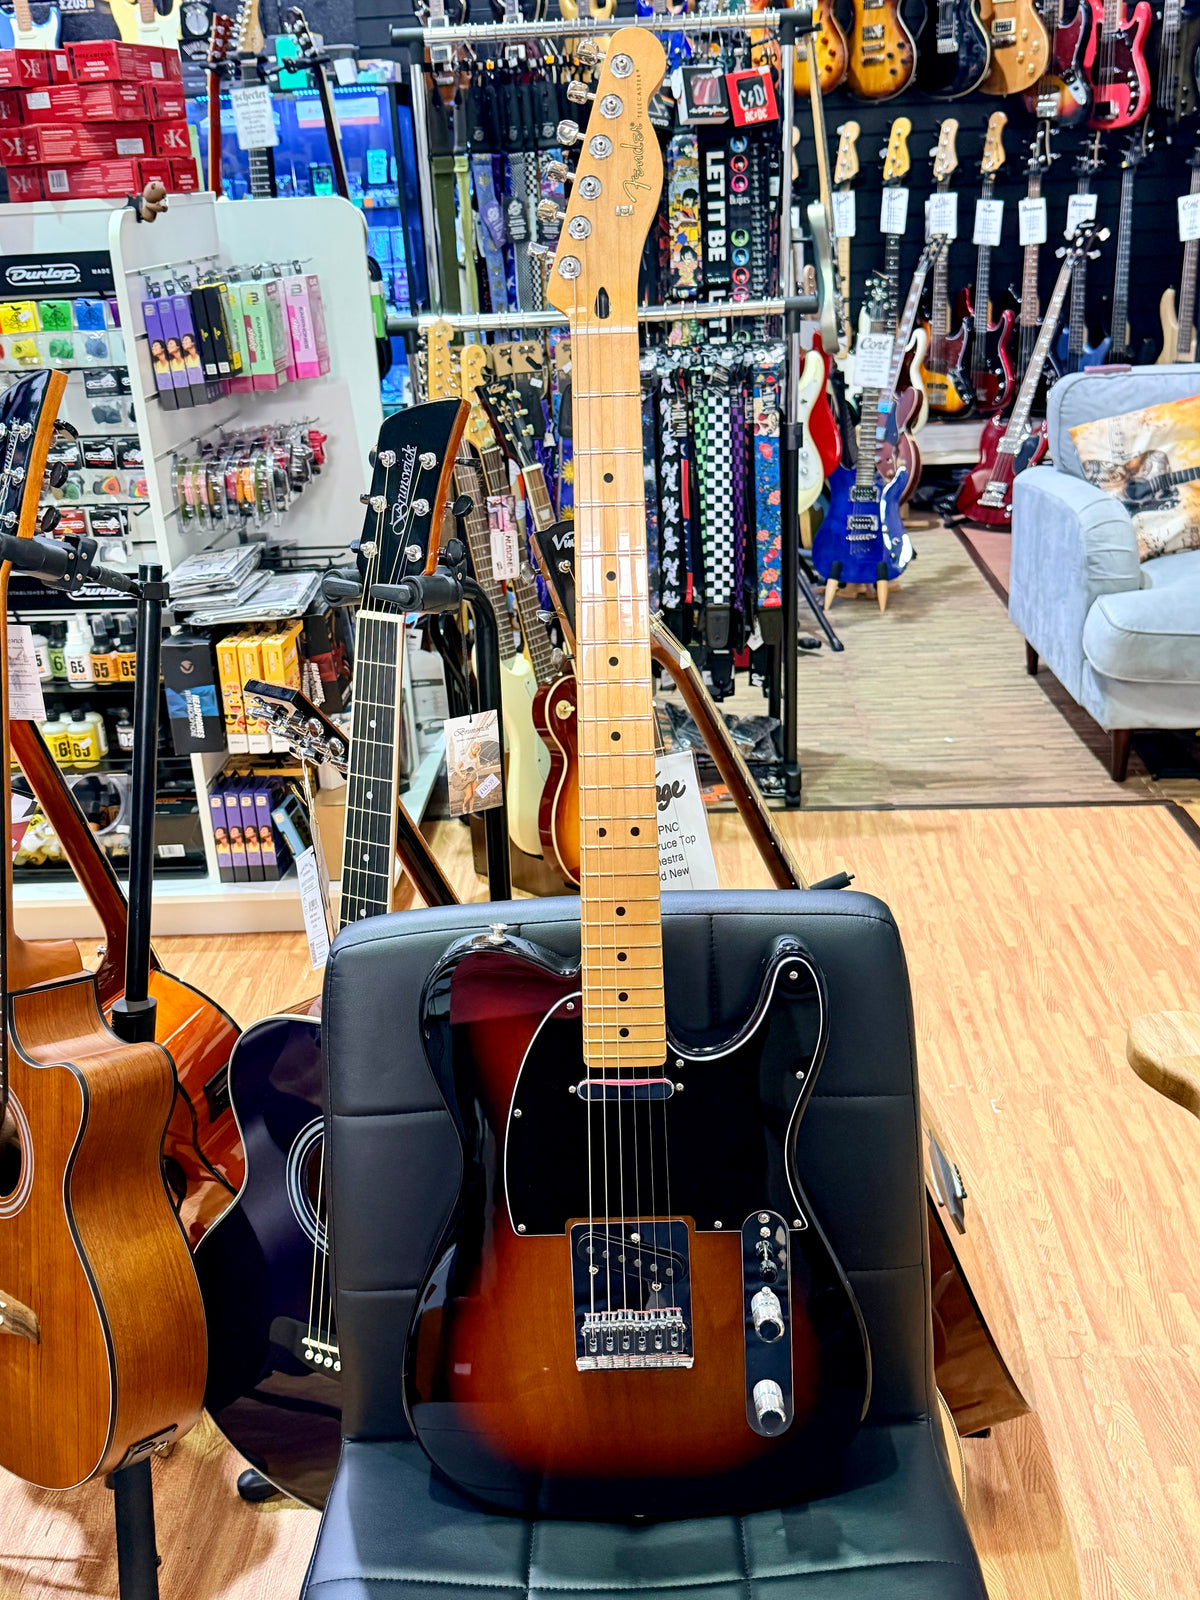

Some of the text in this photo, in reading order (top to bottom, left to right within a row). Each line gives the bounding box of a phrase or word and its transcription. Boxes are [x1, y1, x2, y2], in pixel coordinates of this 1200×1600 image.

[635, 69, 643, 119] TELECASTER
[622, 122, 651, 203] Fender
[706, 150, 726, 197] LET
[707, 200, 726, 227] IT
[707, 229, 727, 262] BE
[11, 267, 76, 281] Dunlop
[860, 337, 890, 351] Cort
[390, 444, 418, 535] Brunswick
[70, 660, 85, 674] 65
[93, 662, 109, 678] 65
[191, 694, 206, 739] HEADPHONES
[679, 834, 696, 845] Top
[669, 867, 690, 879] New
